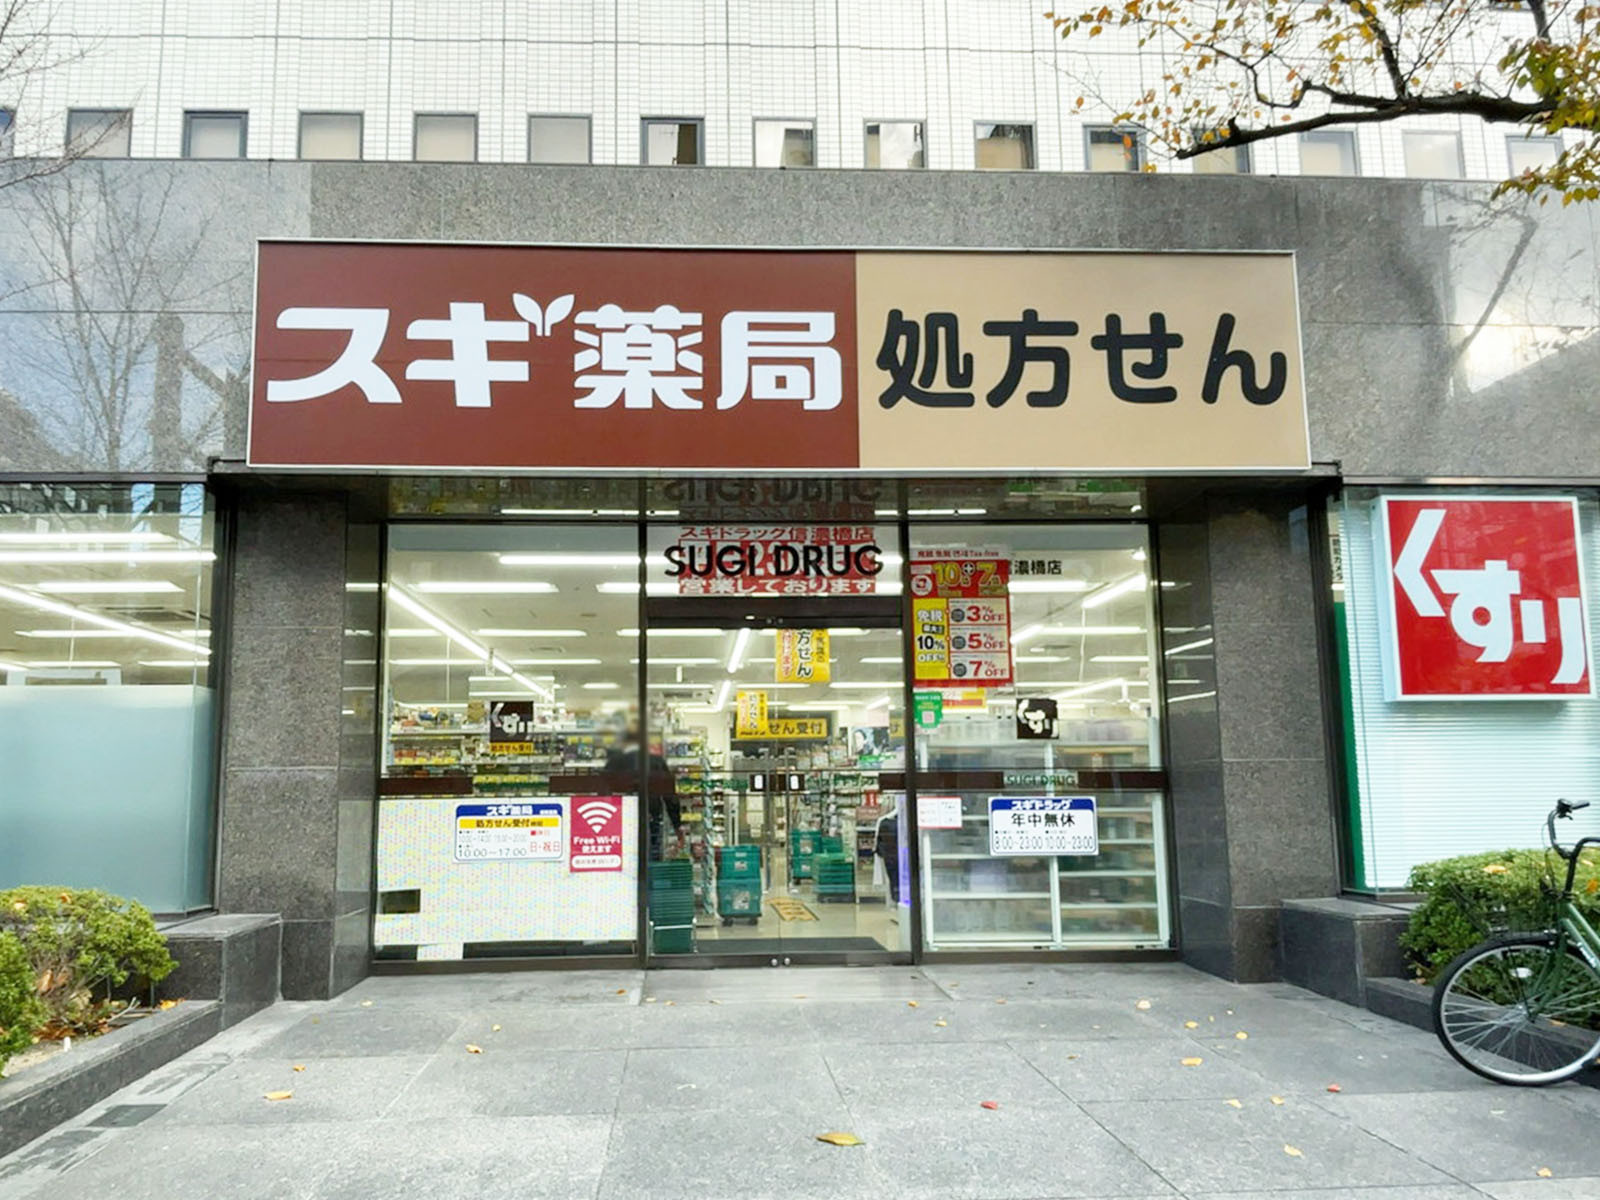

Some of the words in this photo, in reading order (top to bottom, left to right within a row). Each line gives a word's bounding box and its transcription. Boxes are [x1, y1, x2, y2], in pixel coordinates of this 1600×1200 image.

[266, 293, 843, 412] スギ薬局
[876, 308, 1287, 409] 処方せん
[680, 527, 875, 541] スギドラッグ信濃橋店
[664, 545, 757, 577] SUGI
[773, 545, 884, 577] DRUG
[680, 579, 876, 594] 営業しております
[1393, 509, 1587, 684] くすり
[917, 635, 945, 650] 10%
[1011, 812, 1076, 828] 年中無休
